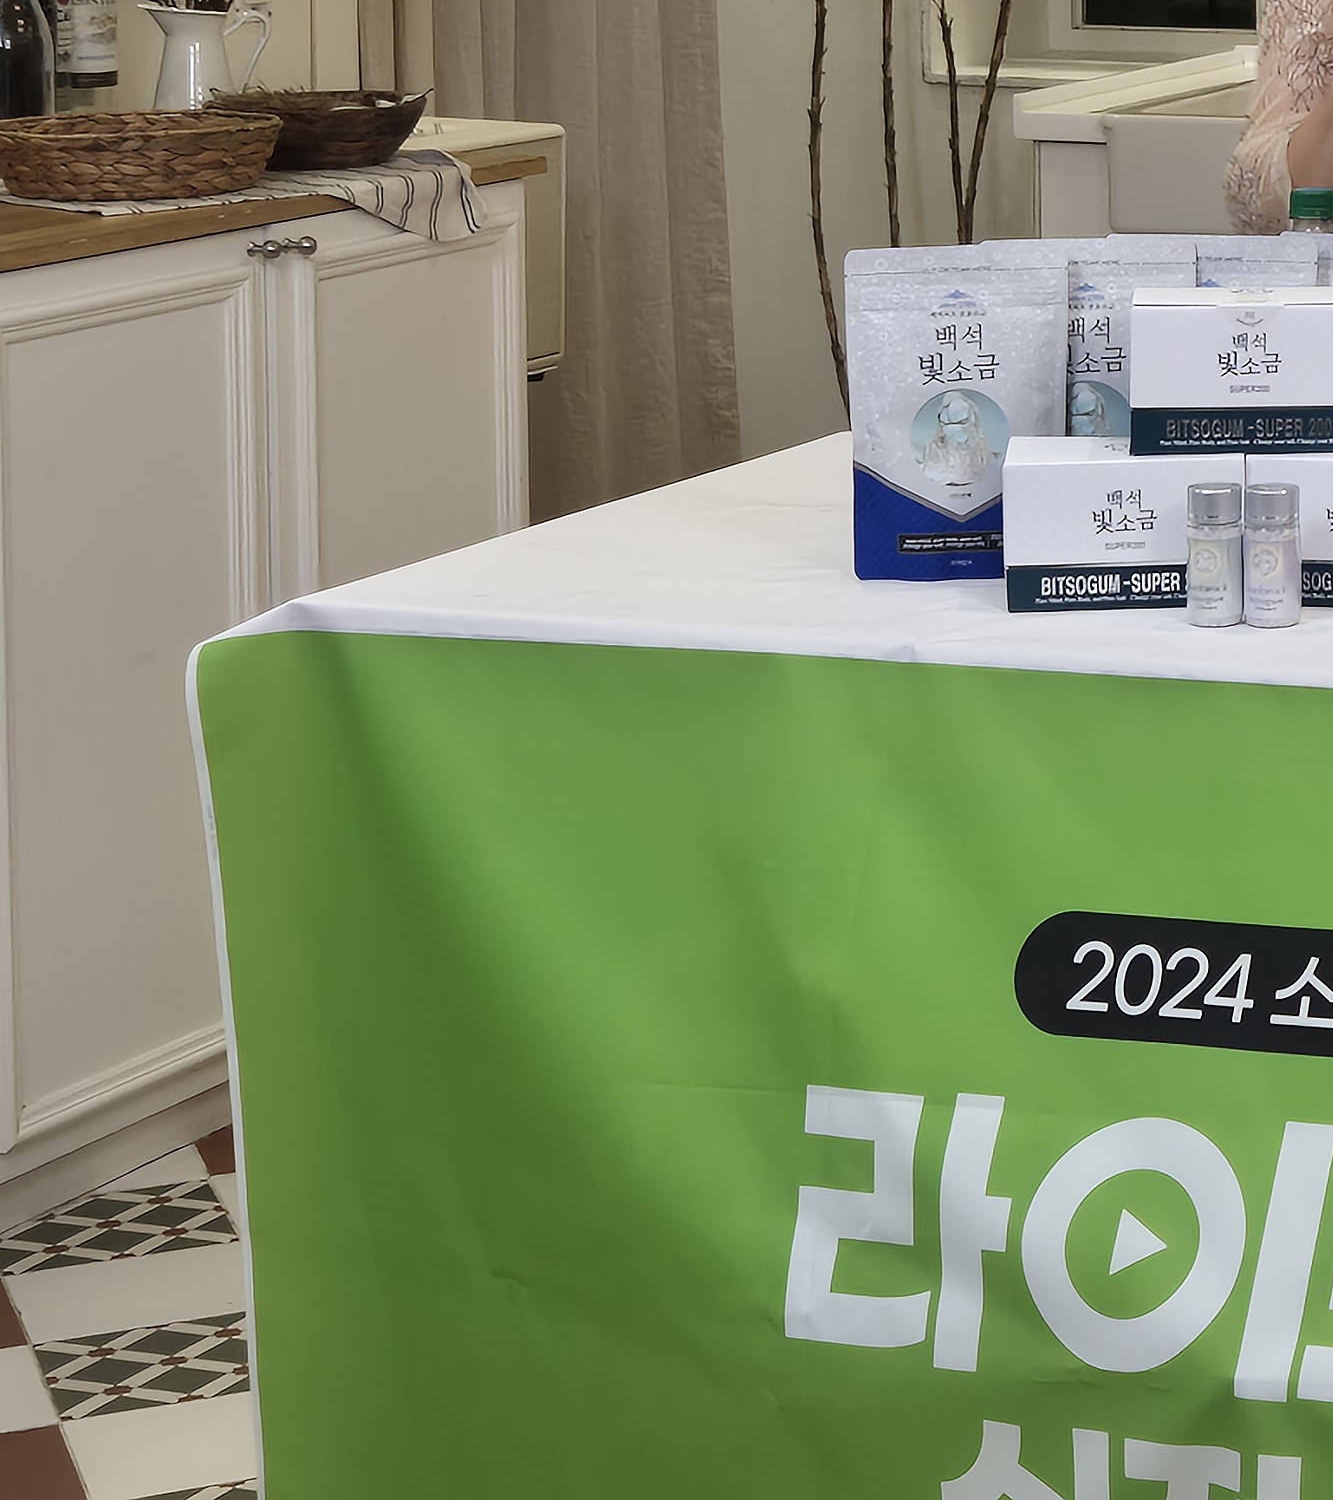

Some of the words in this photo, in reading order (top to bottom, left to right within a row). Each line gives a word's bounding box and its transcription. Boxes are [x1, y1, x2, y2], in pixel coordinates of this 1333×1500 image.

[935, 322, 983, 351] 백석
[1231, 332, 1268, 354] 백석
[917, 352, 1001, 386] 빛소금
[1217, 350, 1283, 378] 빛소금
[1106, 488, 1142, 510] 백석
[1092, 508, 1158, 535] 빛소금
[1040, 573, 1121, 596] BITSOGUM
[1065, 940, 1255, 1024] 2024
